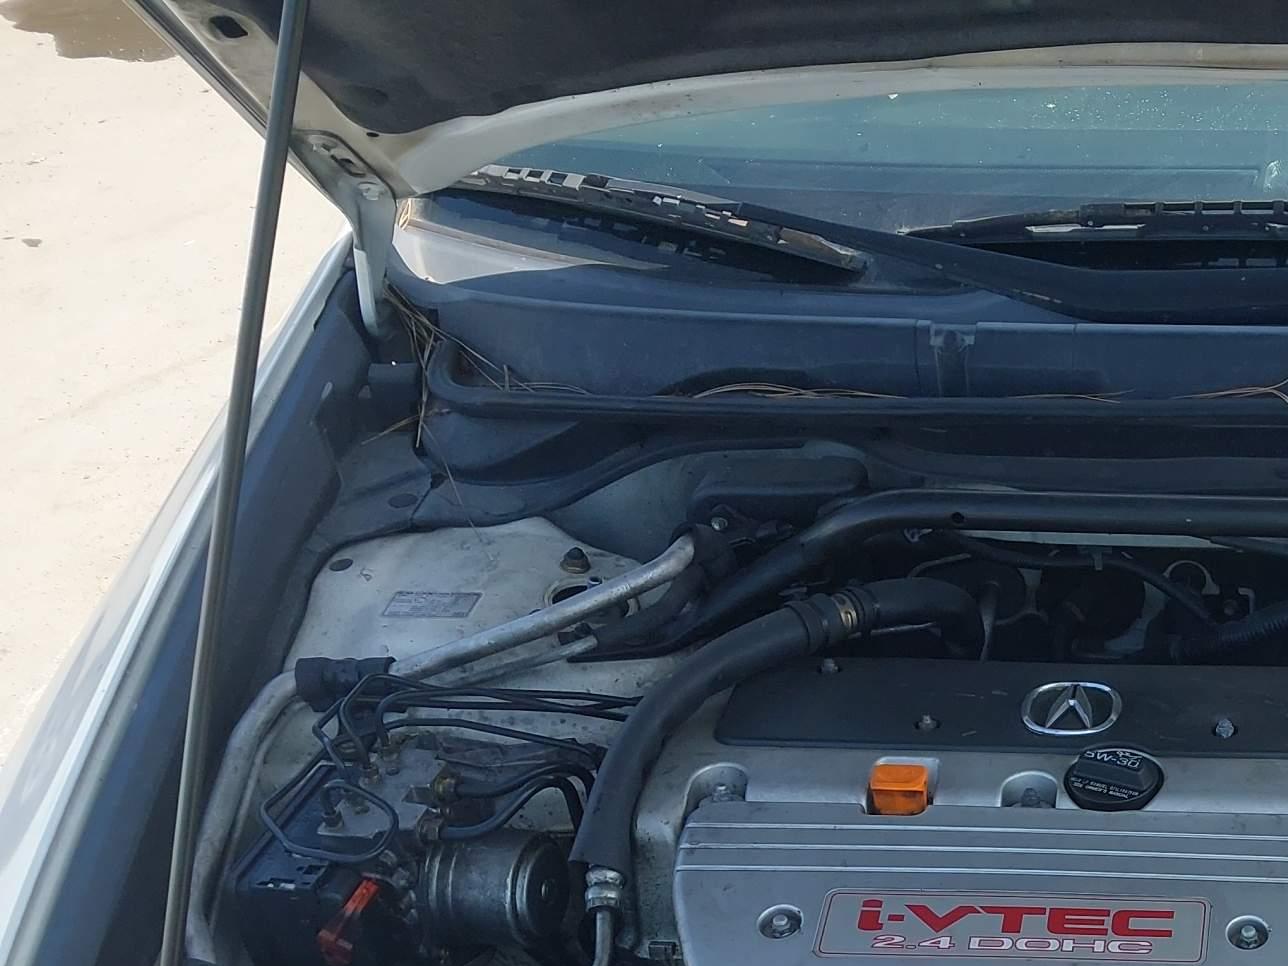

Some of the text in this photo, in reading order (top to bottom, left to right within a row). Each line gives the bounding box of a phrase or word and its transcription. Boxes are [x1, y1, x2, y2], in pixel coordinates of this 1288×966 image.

[1084, 751, 1140, 768] 5W-30
[858, 898, 1176, 938] i-VTEC
[871, 934, 1153, 954] 2.4 DOHC
